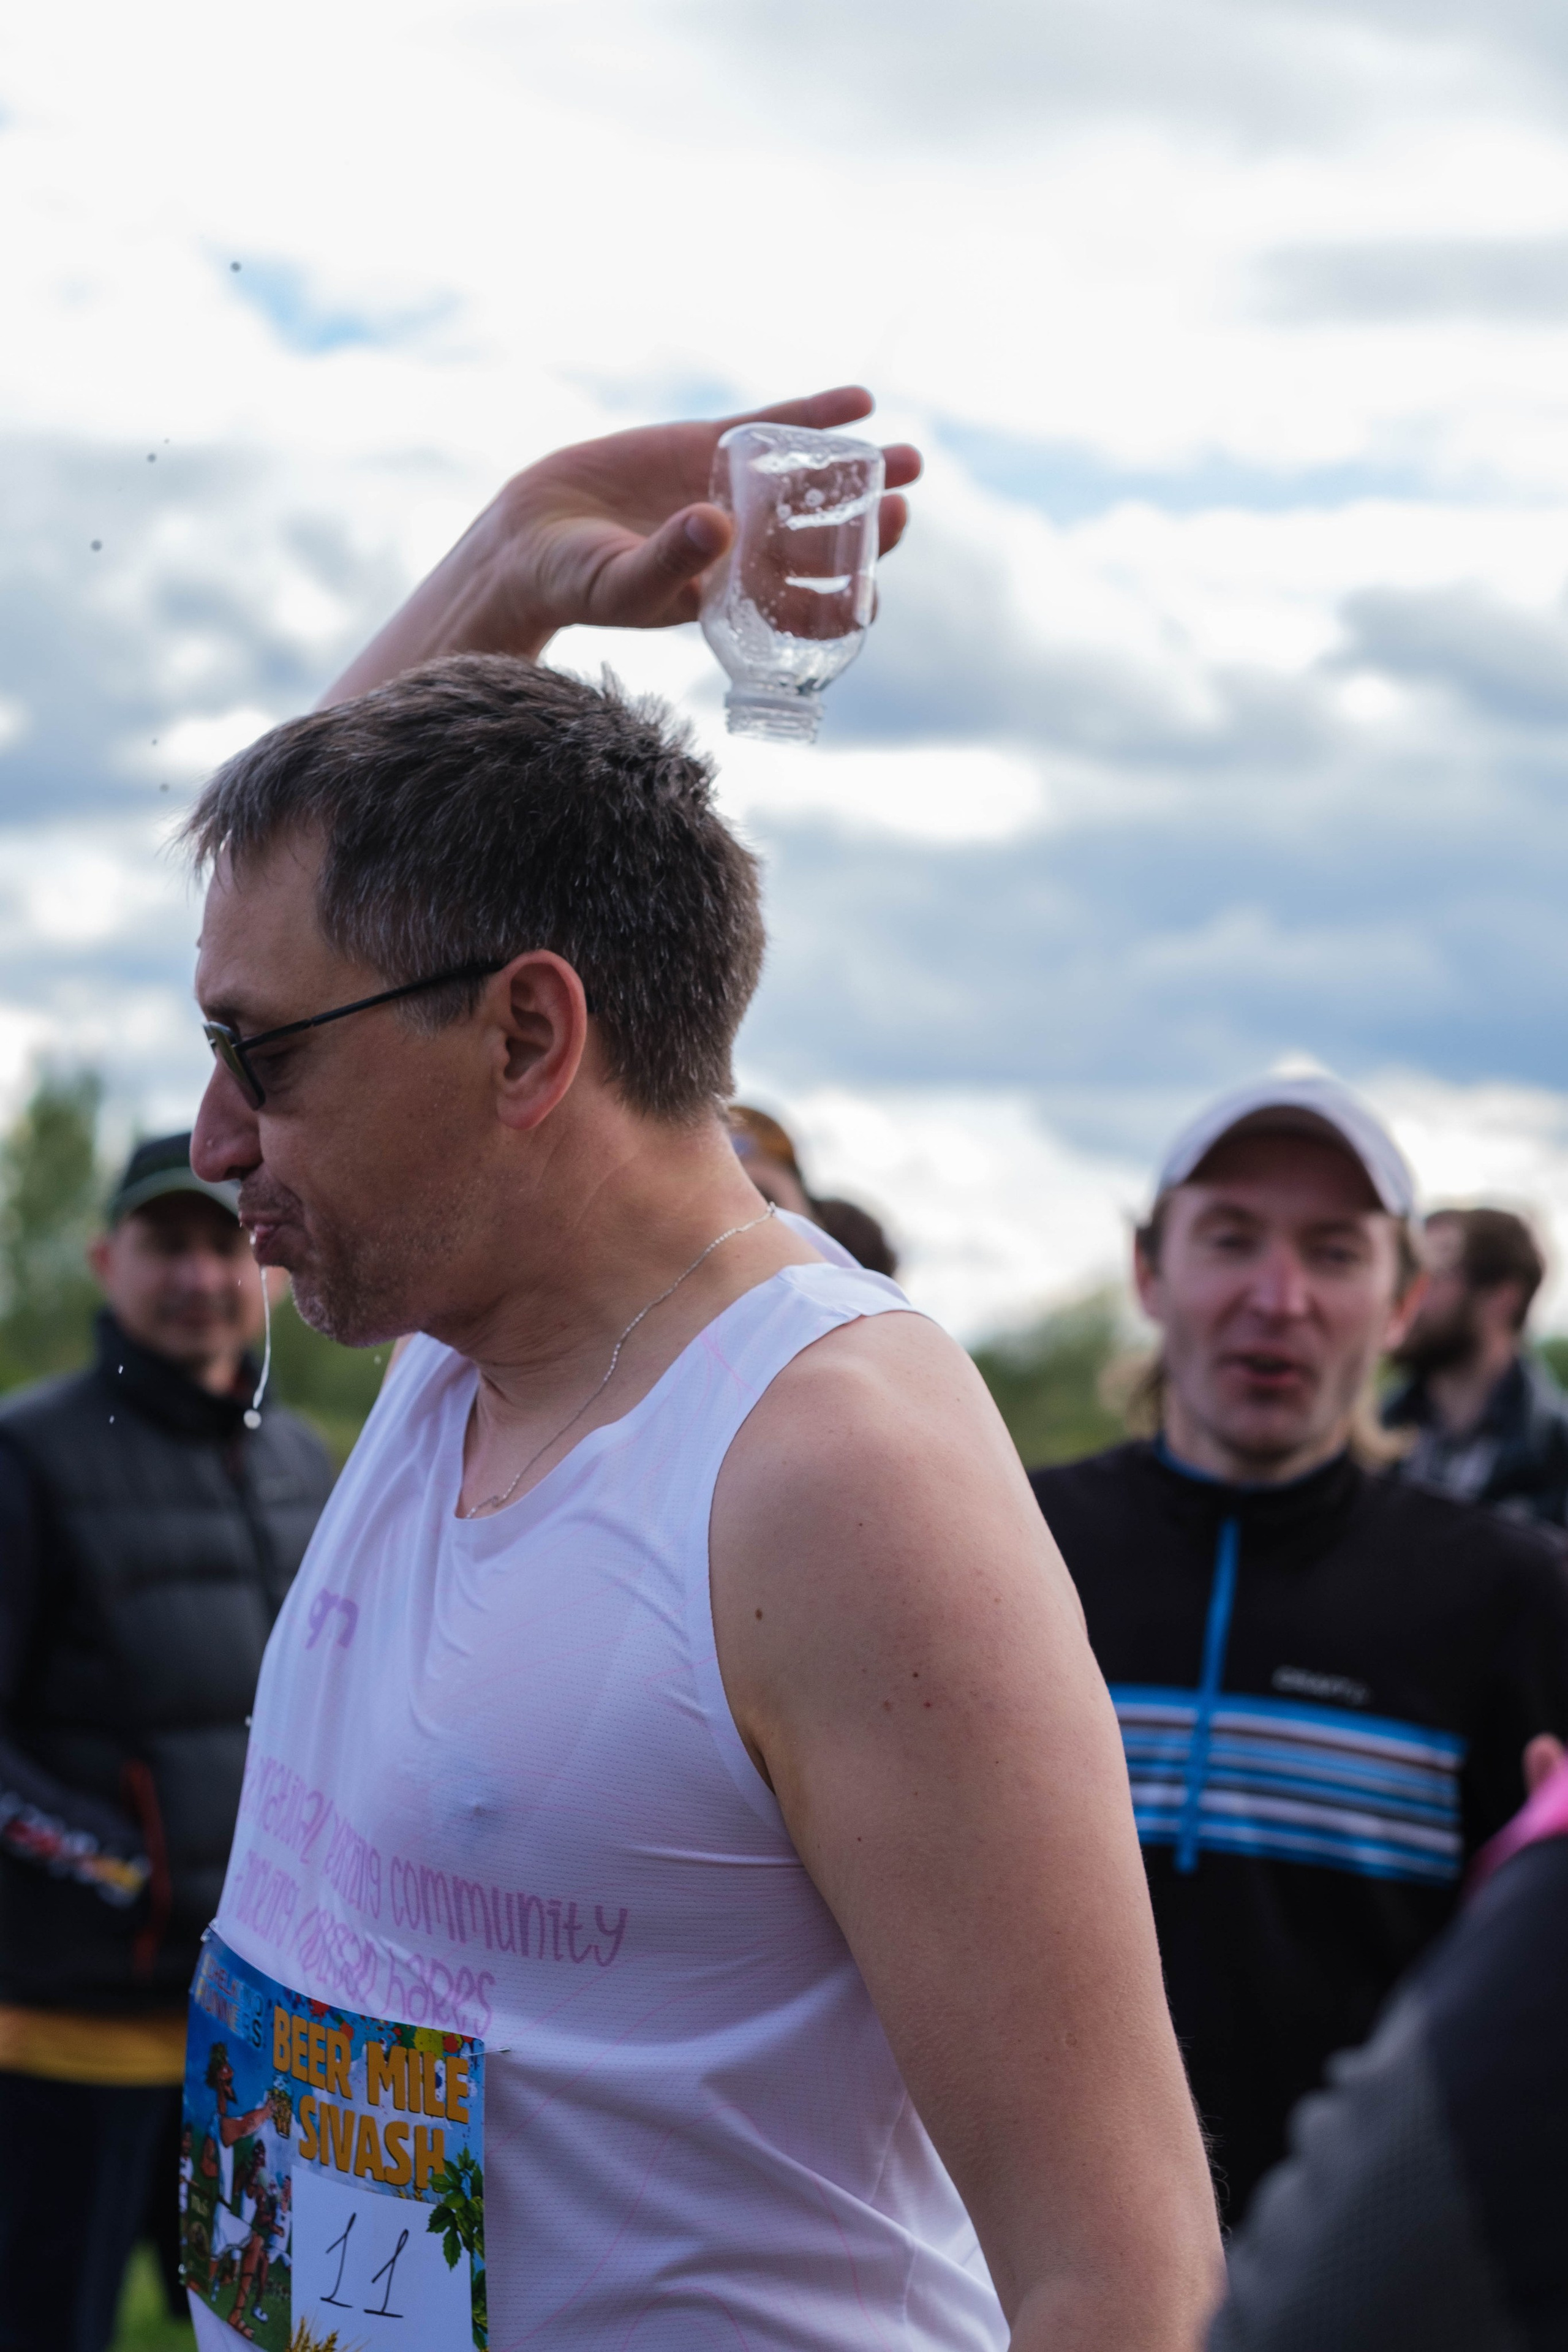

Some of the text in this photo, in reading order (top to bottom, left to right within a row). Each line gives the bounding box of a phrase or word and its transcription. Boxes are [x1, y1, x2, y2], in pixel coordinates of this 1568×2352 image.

[390, 1856, 627, 1966] community
[273, 2005, 469, 2124] BEER MILE
[299, 2095, 445, 2193] SIVASH
